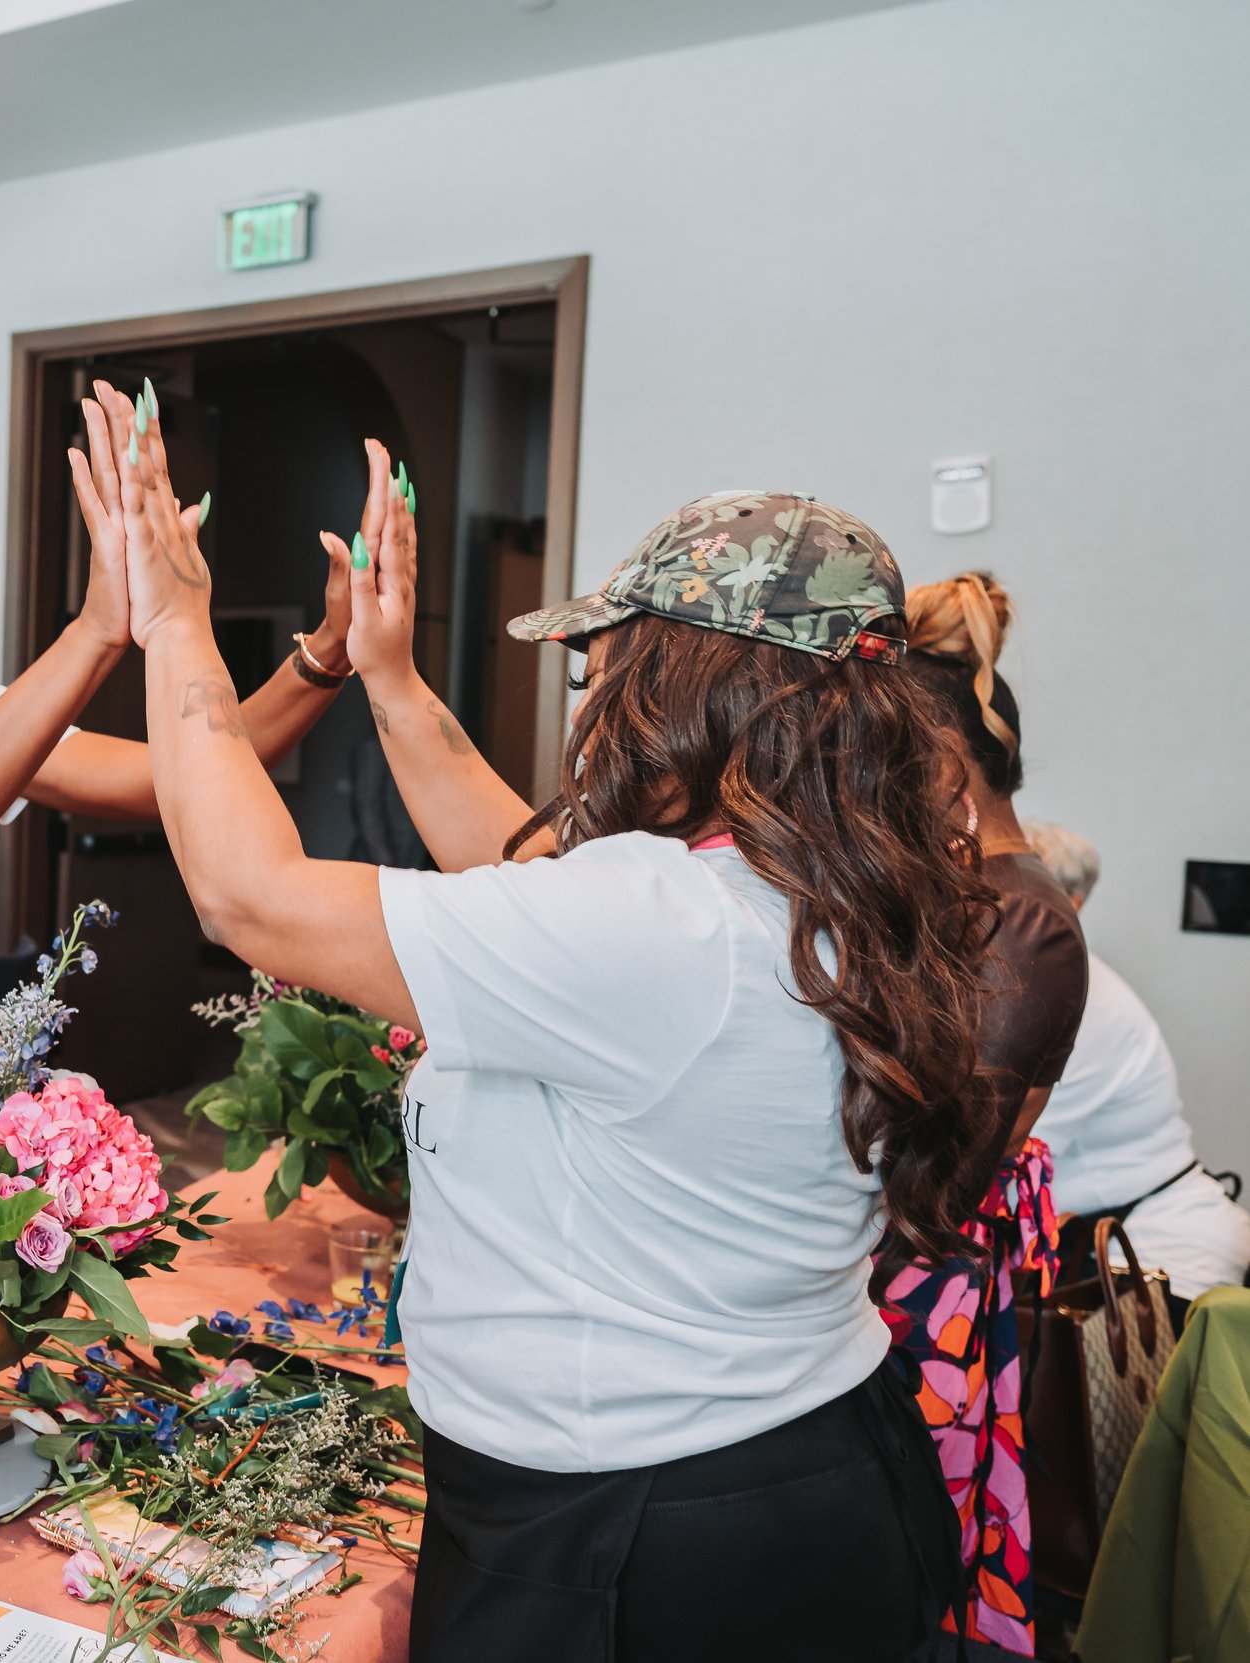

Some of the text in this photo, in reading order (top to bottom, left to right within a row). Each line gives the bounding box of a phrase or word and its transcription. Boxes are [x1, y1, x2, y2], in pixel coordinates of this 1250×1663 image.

[232, 203, 297, 268] EXIT
[4, 1643, 16, 1652] WE
[13, 1629, 29, 1645] ARE?
